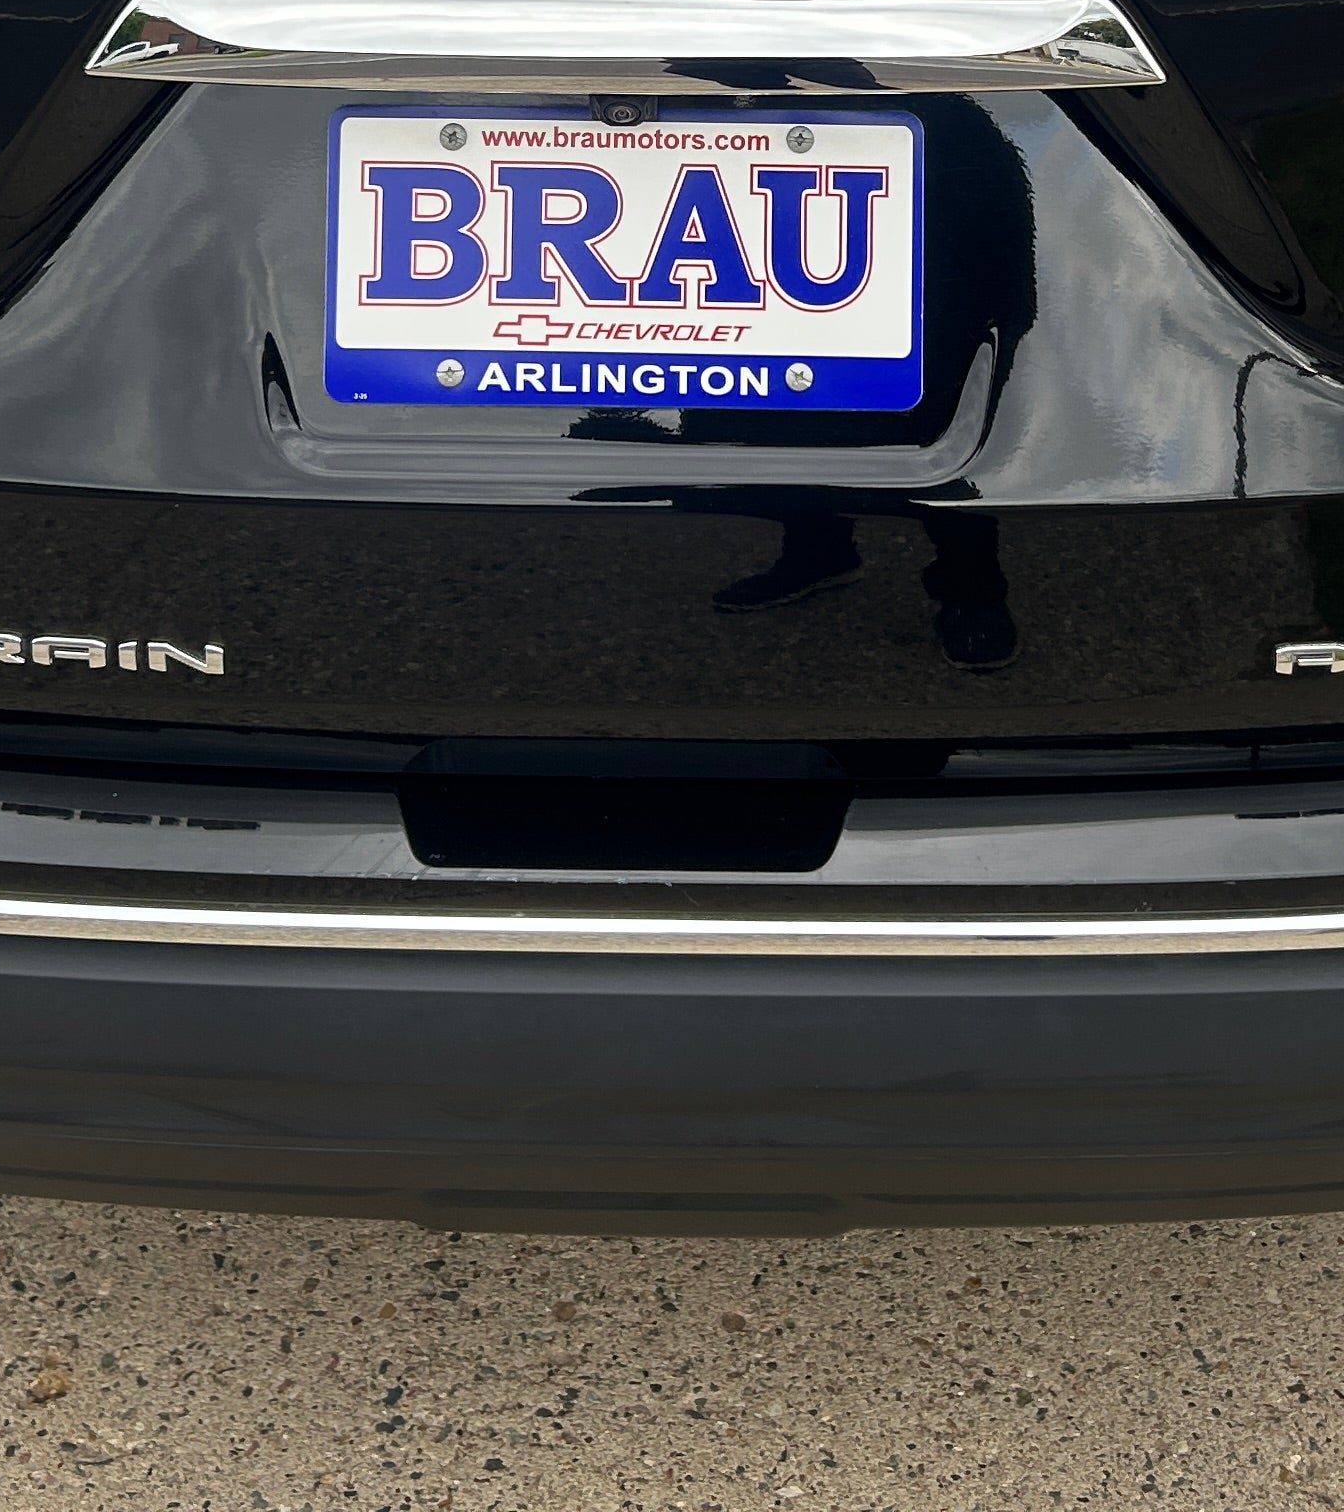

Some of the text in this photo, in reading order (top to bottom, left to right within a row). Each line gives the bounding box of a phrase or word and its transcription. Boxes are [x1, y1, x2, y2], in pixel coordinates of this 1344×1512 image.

[481, 126, 770, 152] www.braumotors.com
[358, 159, 889, 313] BRAU
[574, 322, 752, 343] CHEVROLET
[477, 361, 769, 397] ARLINGTON
